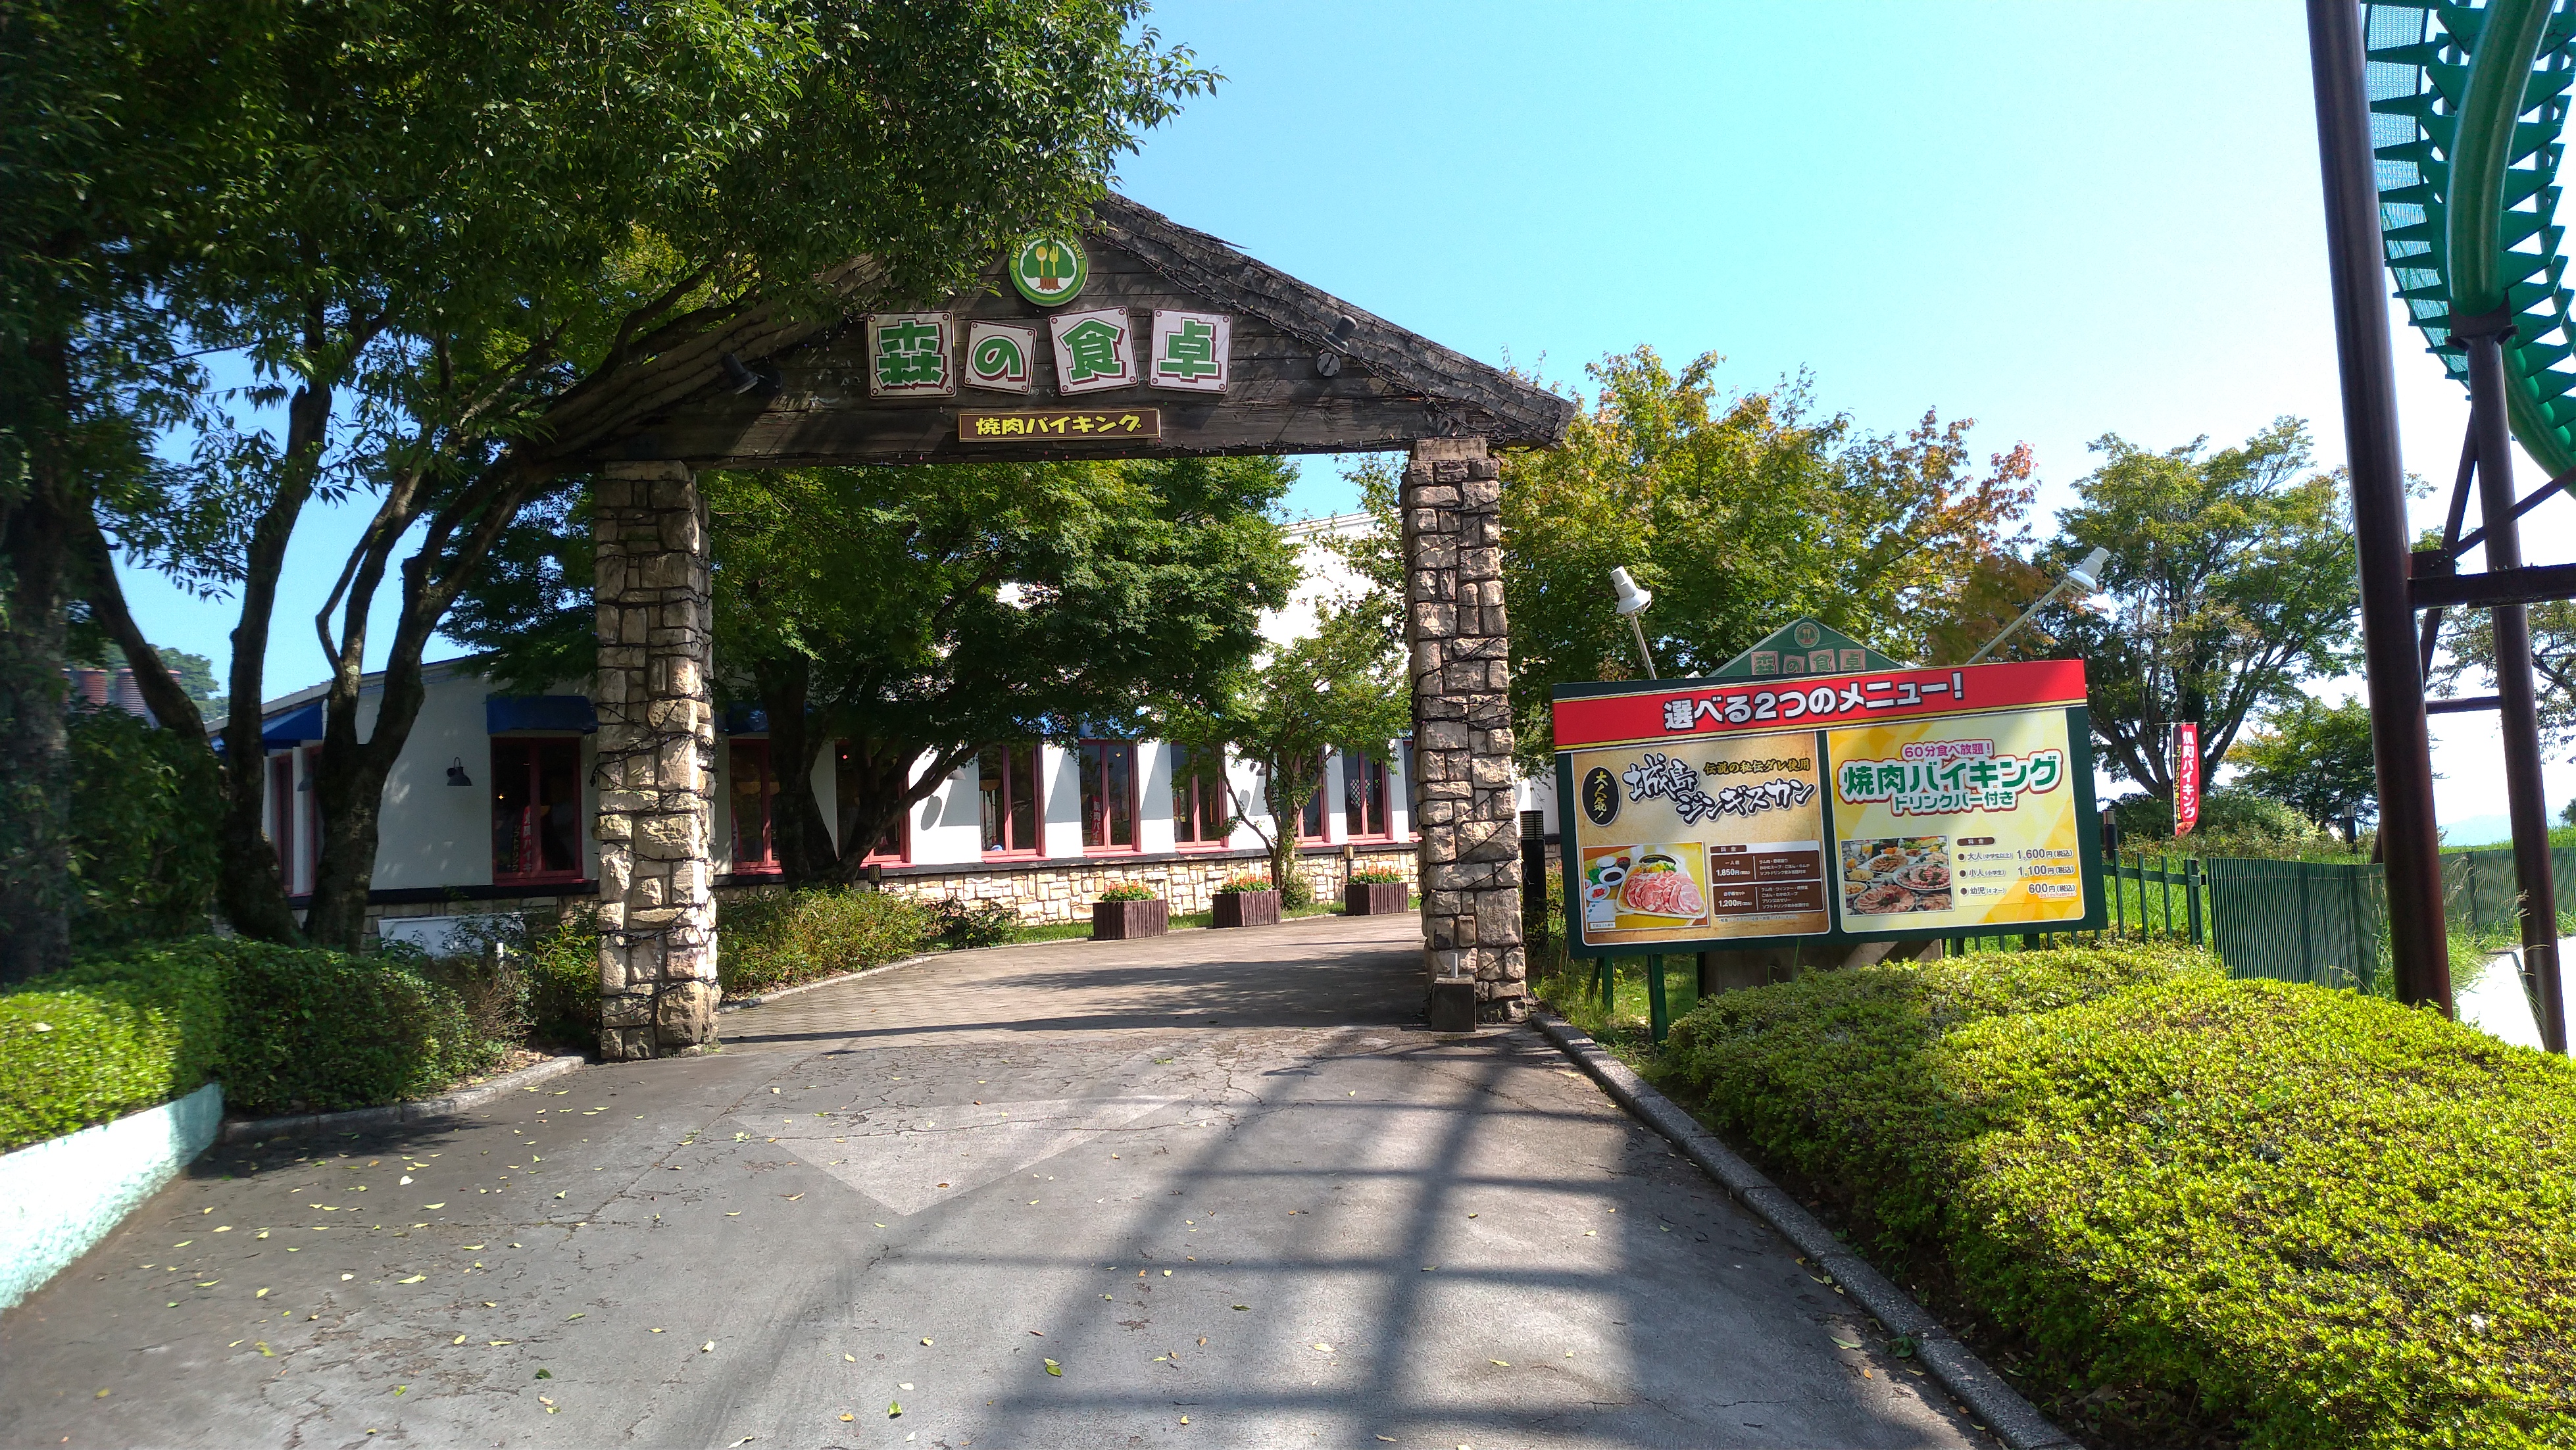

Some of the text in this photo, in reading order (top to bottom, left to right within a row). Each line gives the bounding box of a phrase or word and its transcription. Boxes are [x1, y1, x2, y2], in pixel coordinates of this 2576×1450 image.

[875, 317, 1222, 389] 森の食卓
[976, 414, 1142, 436] 焼肉バイキング
[1754, 653, 1862, 674] 森の食卓
[1664, 672, 1963, 730] 選べる2つのメニュー!
[1704, 759, 1811, 776] 伝説の秘伝ダレ使用
[1904, 743, 1991, 758] 60分食べ放題!
[1593, 770, 1608, 822] 大人気!
[1622, 753, 1698, 802] 城島
[1844, 755, 2058, 796] 焼肉バイキング
[2182, 731, 2196, 818] 焼肉バイキング
[1676, 778, 1816, 825] ジンギスカン
[1895, 791, 2014, 811] ドリンクバー付き
